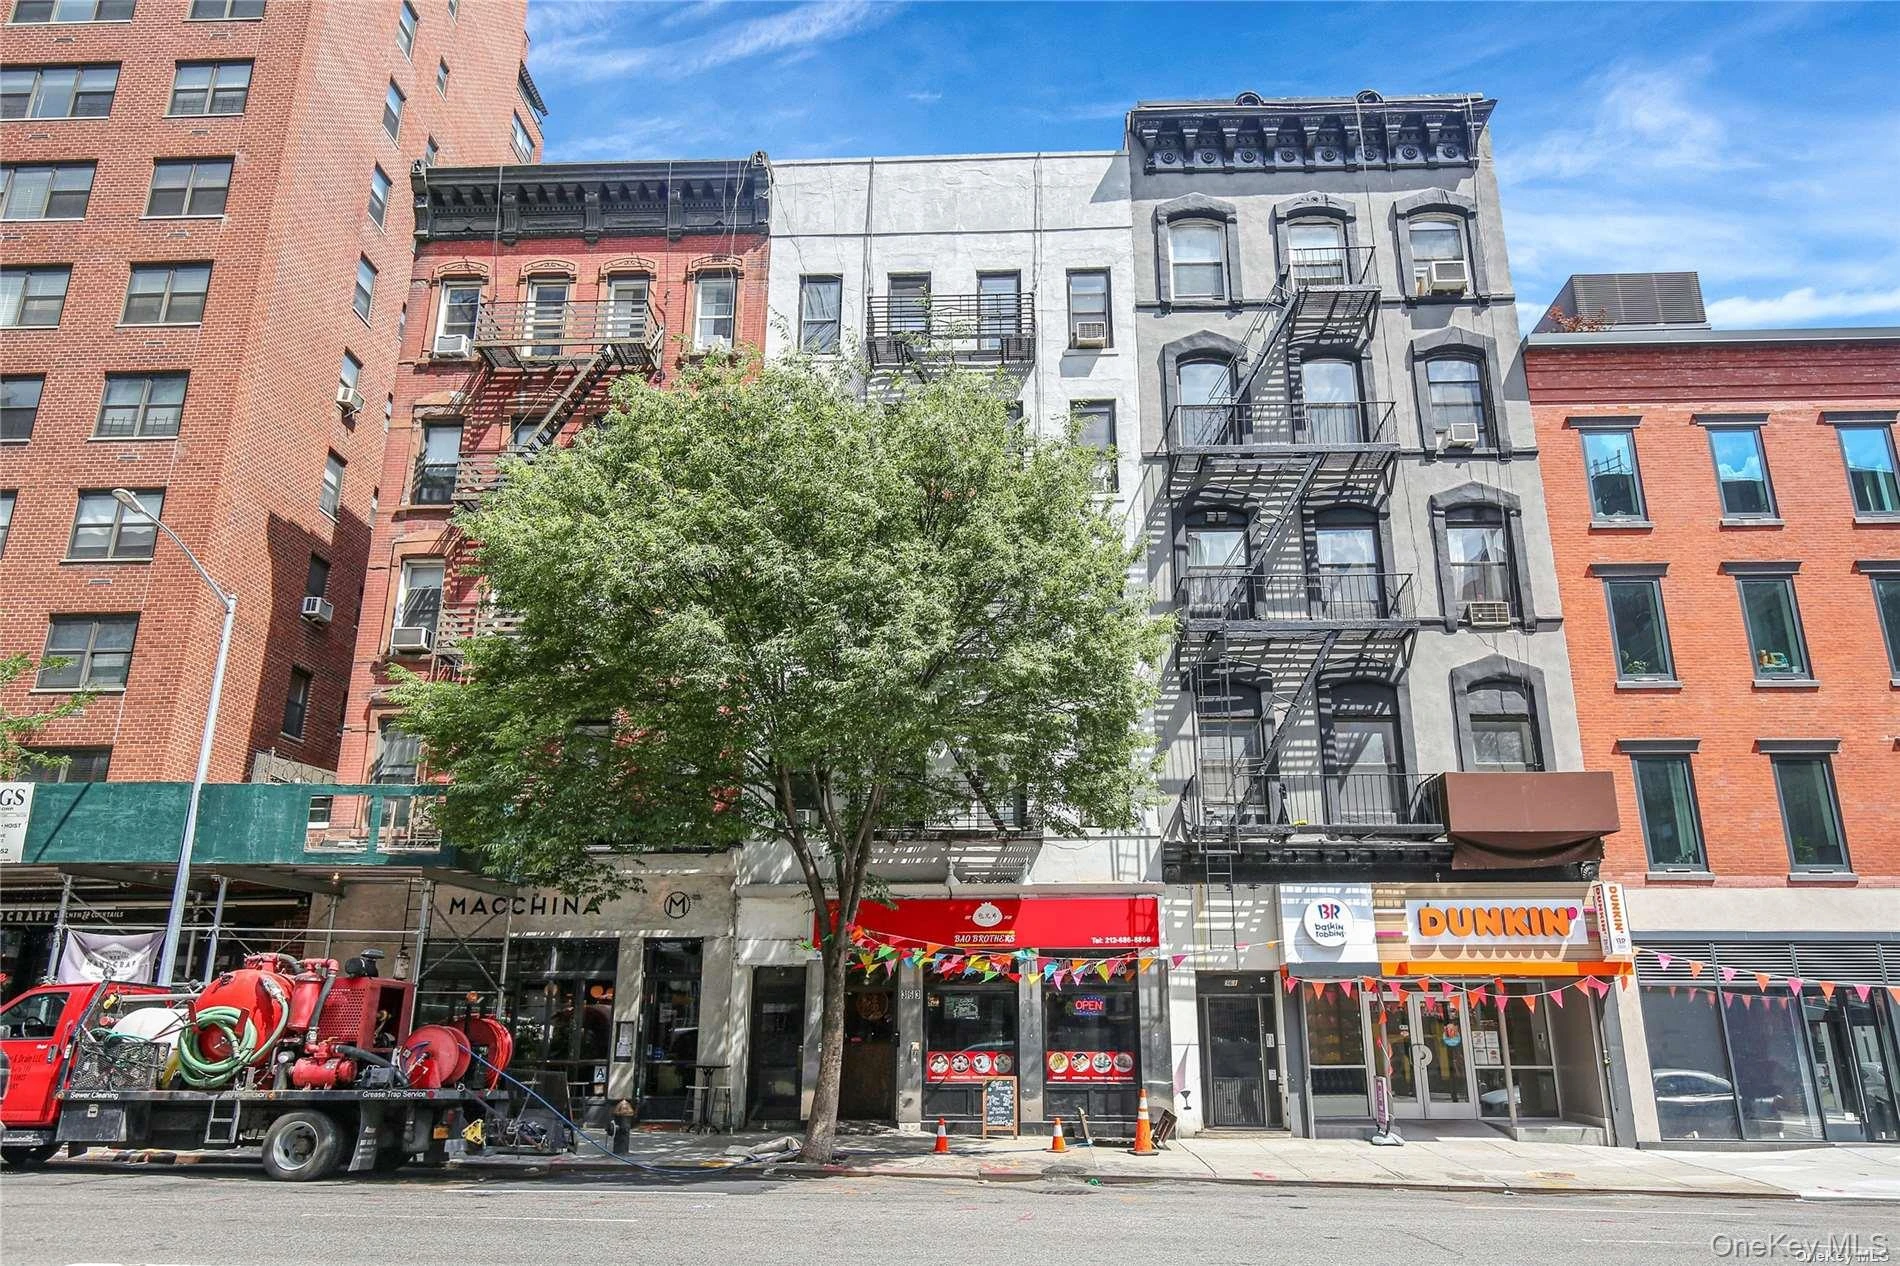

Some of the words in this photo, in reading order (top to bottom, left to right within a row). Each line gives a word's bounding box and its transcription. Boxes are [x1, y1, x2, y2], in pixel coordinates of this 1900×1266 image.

[449, 896, 601, 915] MACCHINA
[1609, 886, 1624, 933] DUNKIN'
[1317, 903, 1340, 919] BR
[1315, 922, 1344, 931] baskin
[1418, 906, 1577, 937] DUNKIN'
[954, 935, 971, 943] BAO
[972, 934, 1016, 943] BROTHERS
[1075, 1000, 1103, 1010] OPEN
[70, 1091, 91, 1099] Sewer
[92, 1091, 119, 1100] Cleaning
[362, 1090, 386, 1098] Grease
[387, 1090, 401, 1098] Trap
[402, 1090, 426, 1098] Service
